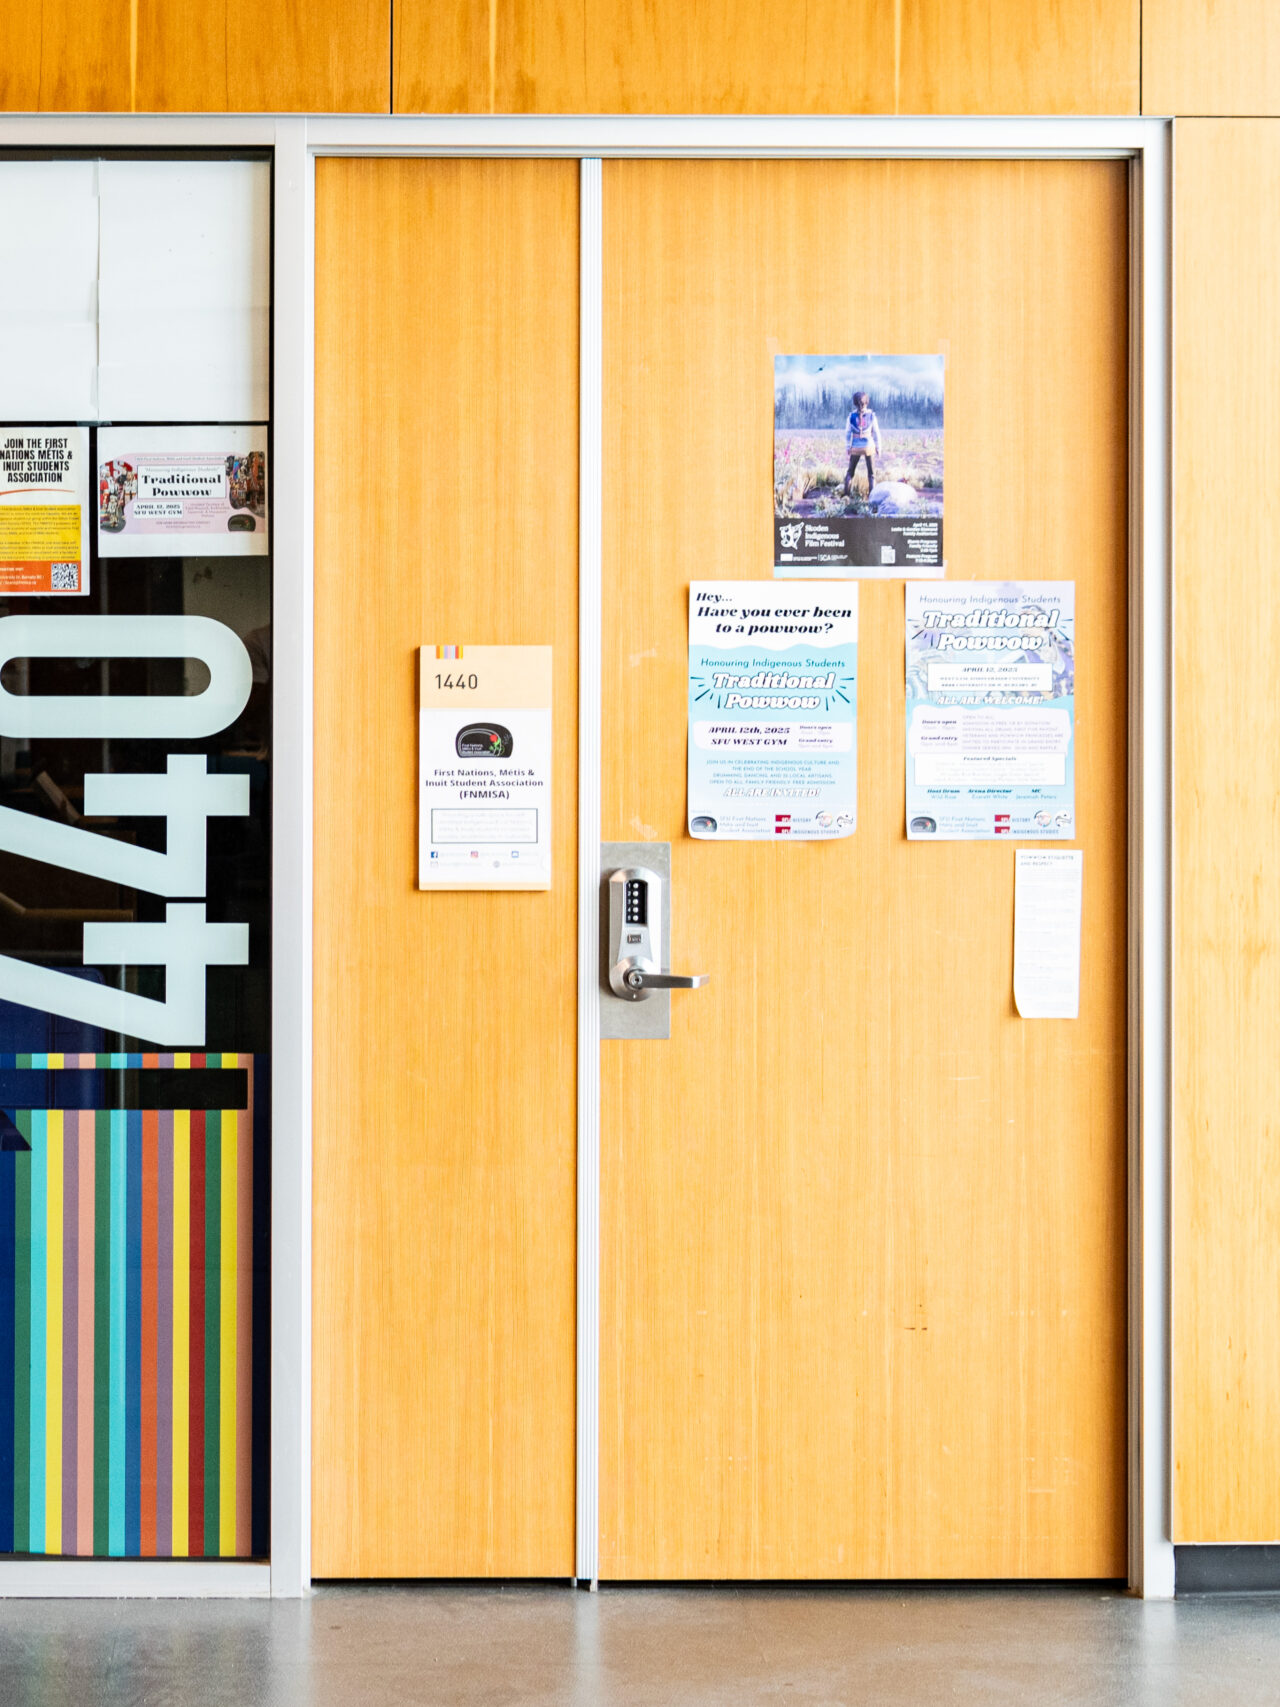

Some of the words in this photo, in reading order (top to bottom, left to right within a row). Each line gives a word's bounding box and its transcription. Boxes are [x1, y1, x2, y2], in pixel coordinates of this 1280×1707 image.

[4, 439, 23, 448] JOIN
[27, 439, 42, 448] THE
[45, 438, 68, 448] FIRST
[0, 451, 35, 460] NATIONS
[38, 447, 64, 460] MÉTIS
[67, 451, 72, 459] &
[3, 462, 24, 471] INUIT
[27, 461, 69, 471] STUDENTS
[8, 472, 62, 483] ASSOCIATION
[142, 474, 221, 484] Traditional
[152, 488, 212, 496] Powwow
[805, 532, 839, 540] Indigenous
[696, 593, 732, 603] Hey...
[920, 595, 966, 604] Honouring
[970, 595, 1018, 604] Indigenous
[1022, 595, 1061, 604] Students
[697, 607, 738, 617] Have
[740, 609, 771, 619] you
[775, 609, 810, 617] ever
[813, 606, 852, 617] been
[923, 609, 1060, 628] Traditional
[715, 623, 732, 633] to
[735, 625, 744, 633] a
[747, 623, 833, 636] powwow?
[936, 633, 1043, 651] Powwow
[701, 658, 749, 668] Honouring
[753, 659, 802, 668] Indigenous
[805, 659, 845, 668] Students
[435, 674, 478, 690] 1440
[713, 671, 836, 689] Traditional
[724, 692, 821, 709] Powwow
[936, 696, 958, 704] ALL
[960, 696, 981, 704] ARE
[983, 696, 1044, 704] WELCOME!
[739, 727, 762, 735] 12th,
[458, 769, 496, 777] Nations,
[460, 790, 509, 800] (FNMISA)
[723, 788, 744, 797] ALL
[746, 788, 769, 797] ARE
[771, 787, 821, 797] INVITED!
